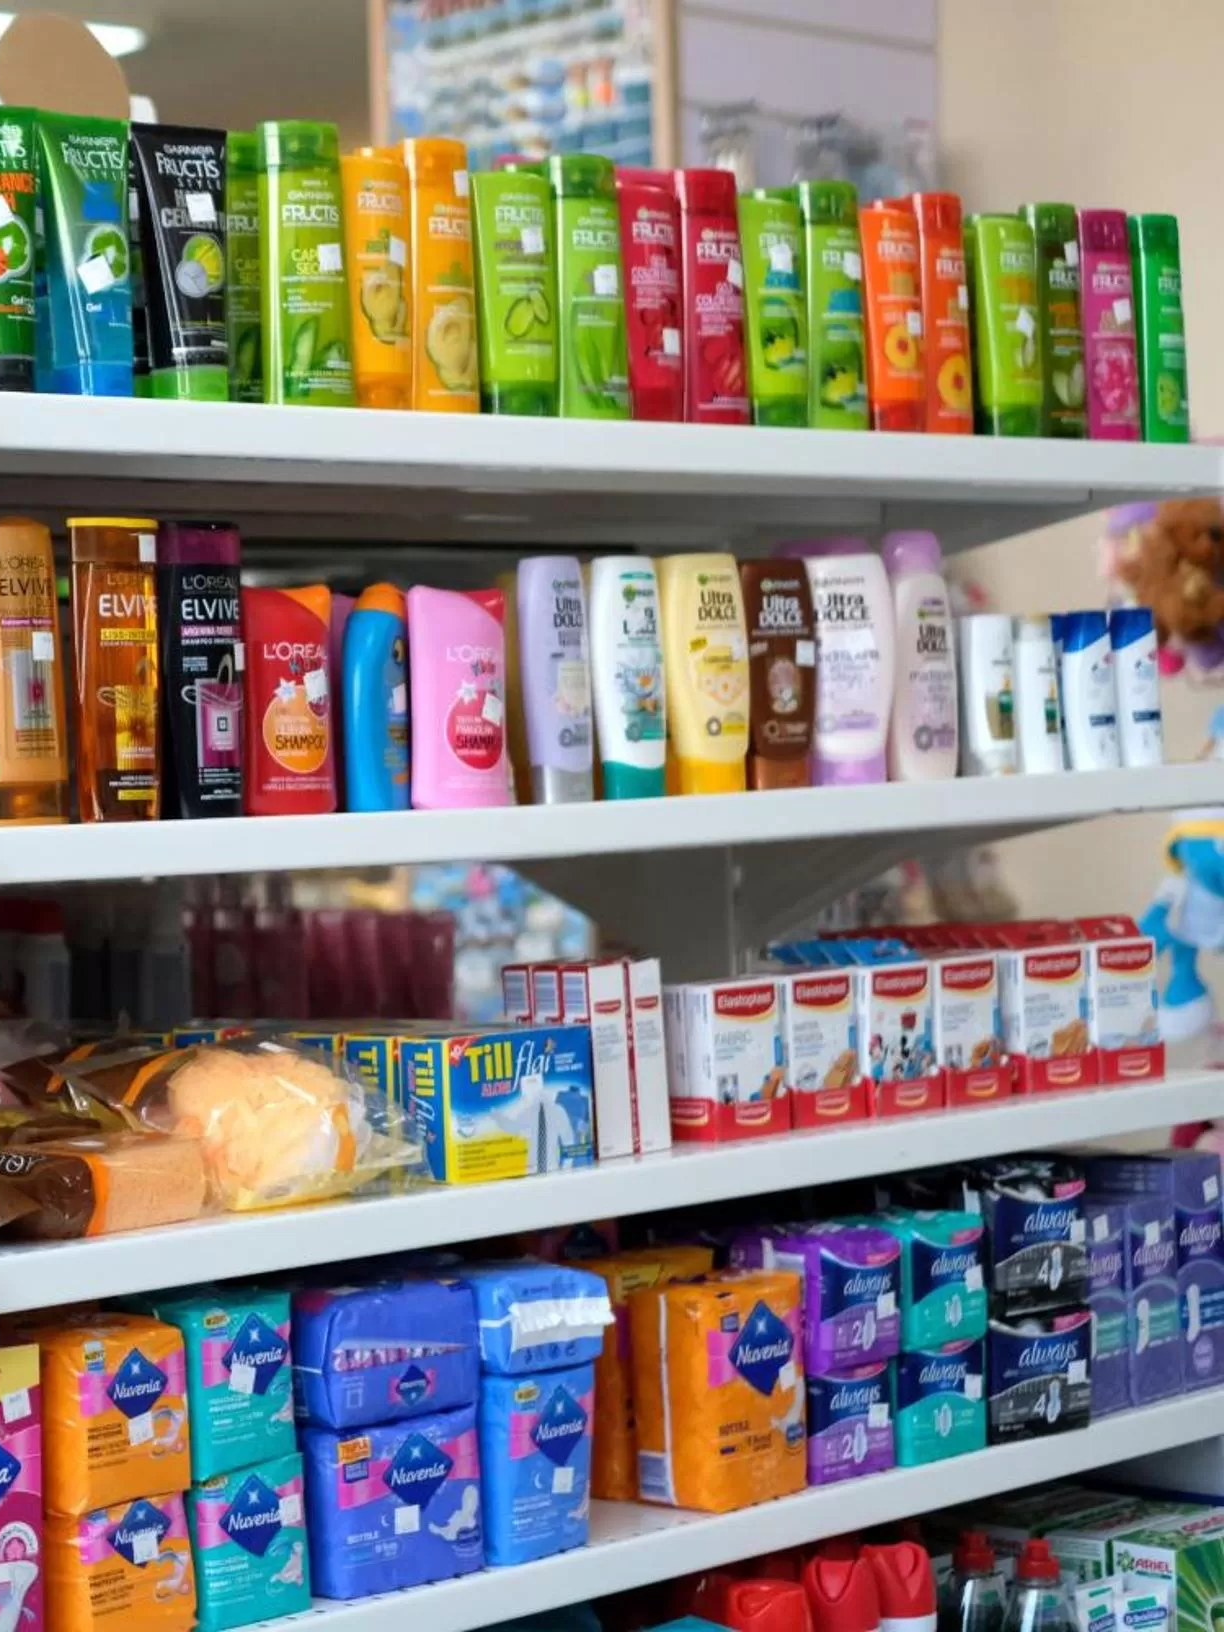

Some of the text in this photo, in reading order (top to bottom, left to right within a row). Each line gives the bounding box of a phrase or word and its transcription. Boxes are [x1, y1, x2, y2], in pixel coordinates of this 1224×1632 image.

[156, 152, 221, 179] FRUCTIS
[281, 204, 339, 222] FRUCTIS
[181, 599, 240, 621] ELVIVE
[700, 591, 733, 607] Ultra
[763, 594, 799, 612] Ultra
[821, 591, 864, 608] Ultra
[698, 606, 737, 622] DOLCE
[759, 611, 802, 628] DOLCE
[816, 607, 870, 621] DOLCE
[796, 982, 846, 1000] Elastoplast
[875, 971, 925, 990] Elastoplast
[717, 991, 771, 1010] Elastoplast
[414, 1048, 435, 1097] Till
[465, 1041, 513, 1083] Till
[1024, 1205, 1078, 1237] always
[1179, 1221, 1222, 1248] always
[930, 1252, 977, 1276] always
[843, 1273, 892, 1297] always
[230, 1346, 283, 1368] Nuvenia
[736, 1339, 790, 1367] Nuvenia
[1018, 1340, 1078, 1368] always
[918, 1360, 968, 1385] always
[112, 1378, 161, 1401] Nuvenia
[829, 1382, 882, 1411] always
[535, 1416, 584, 1441] Nuvenia
[390, 1463, 446, 1487] Nuvenia
[227, 1508, 282, 1532] Nuvenia
